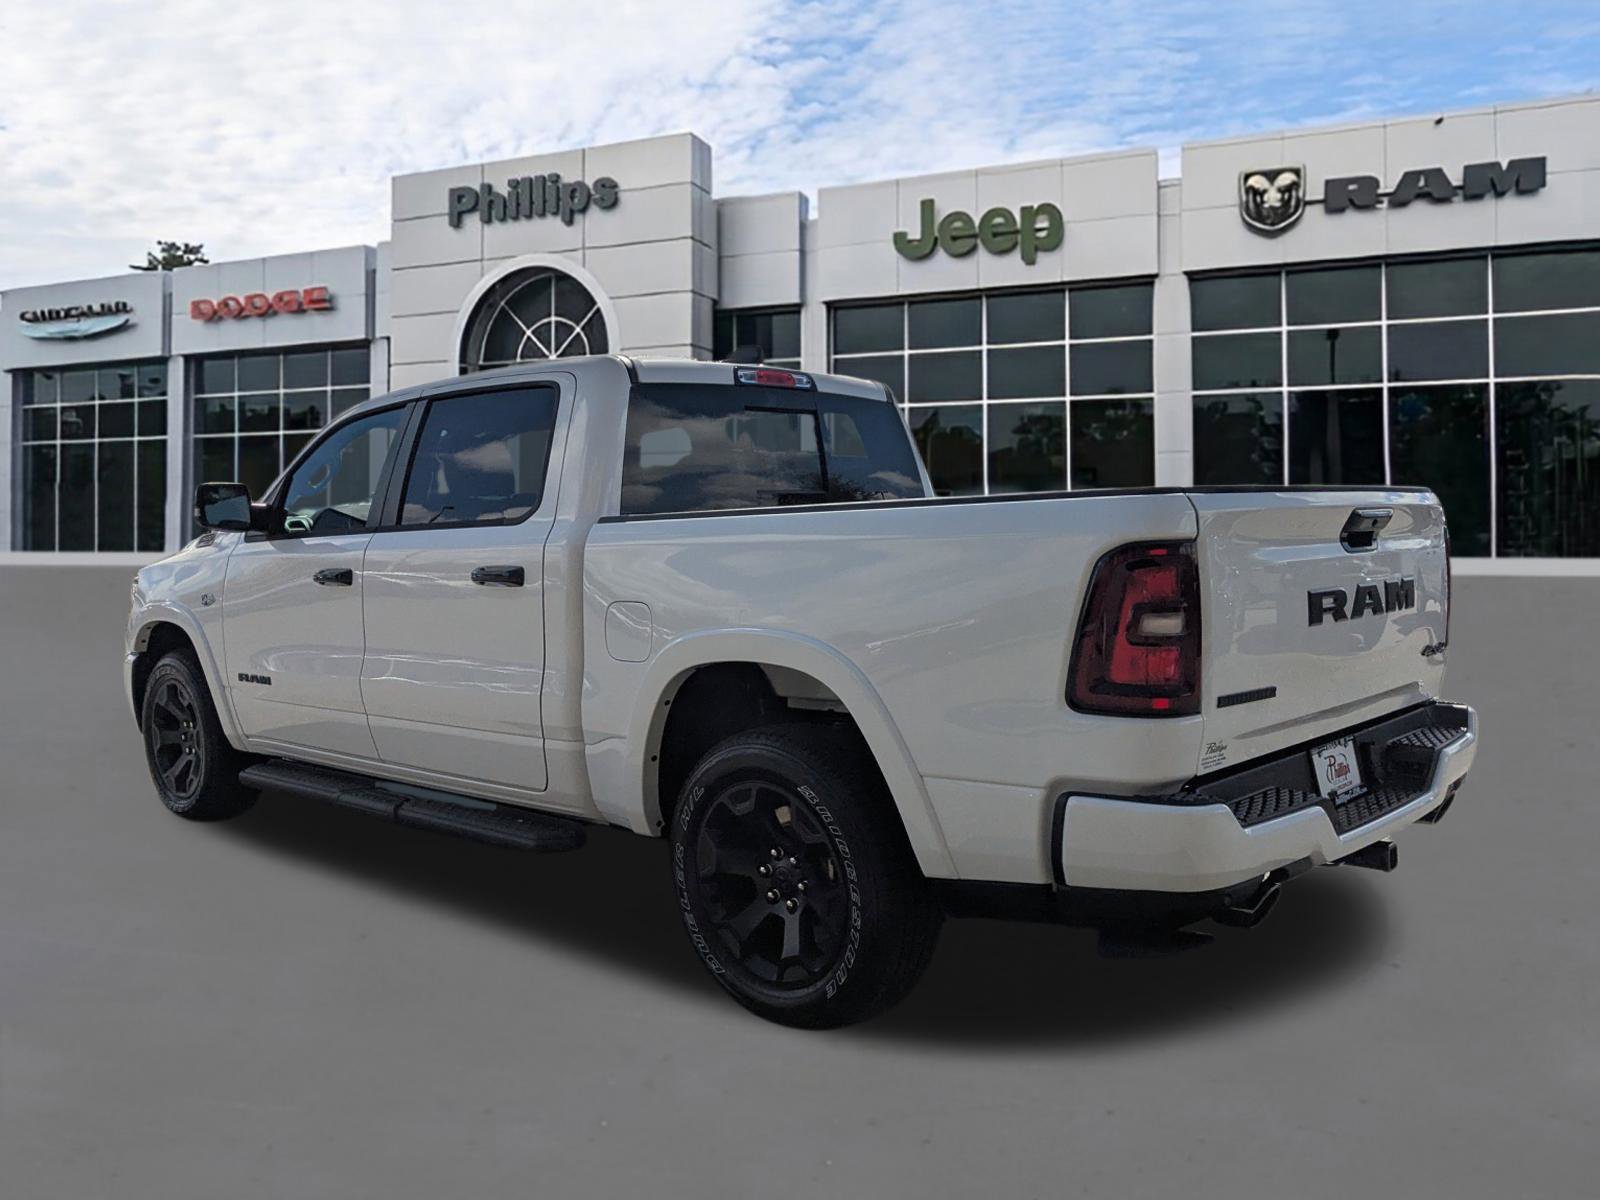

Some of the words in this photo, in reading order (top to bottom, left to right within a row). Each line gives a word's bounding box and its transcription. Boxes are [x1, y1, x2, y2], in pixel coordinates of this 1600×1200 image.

[448, 173, 619, 228] Phillips
[1324, 156, 1547, 213] RAM
[893, 198, 1064, 266] Jeep
[191, 285, 331, 320] DODGE
[1307, 575, 1416, 627] RAM
[238, 672, 272, 685] RAM
[798, 785, 862, 999] BRIDGESTONE
